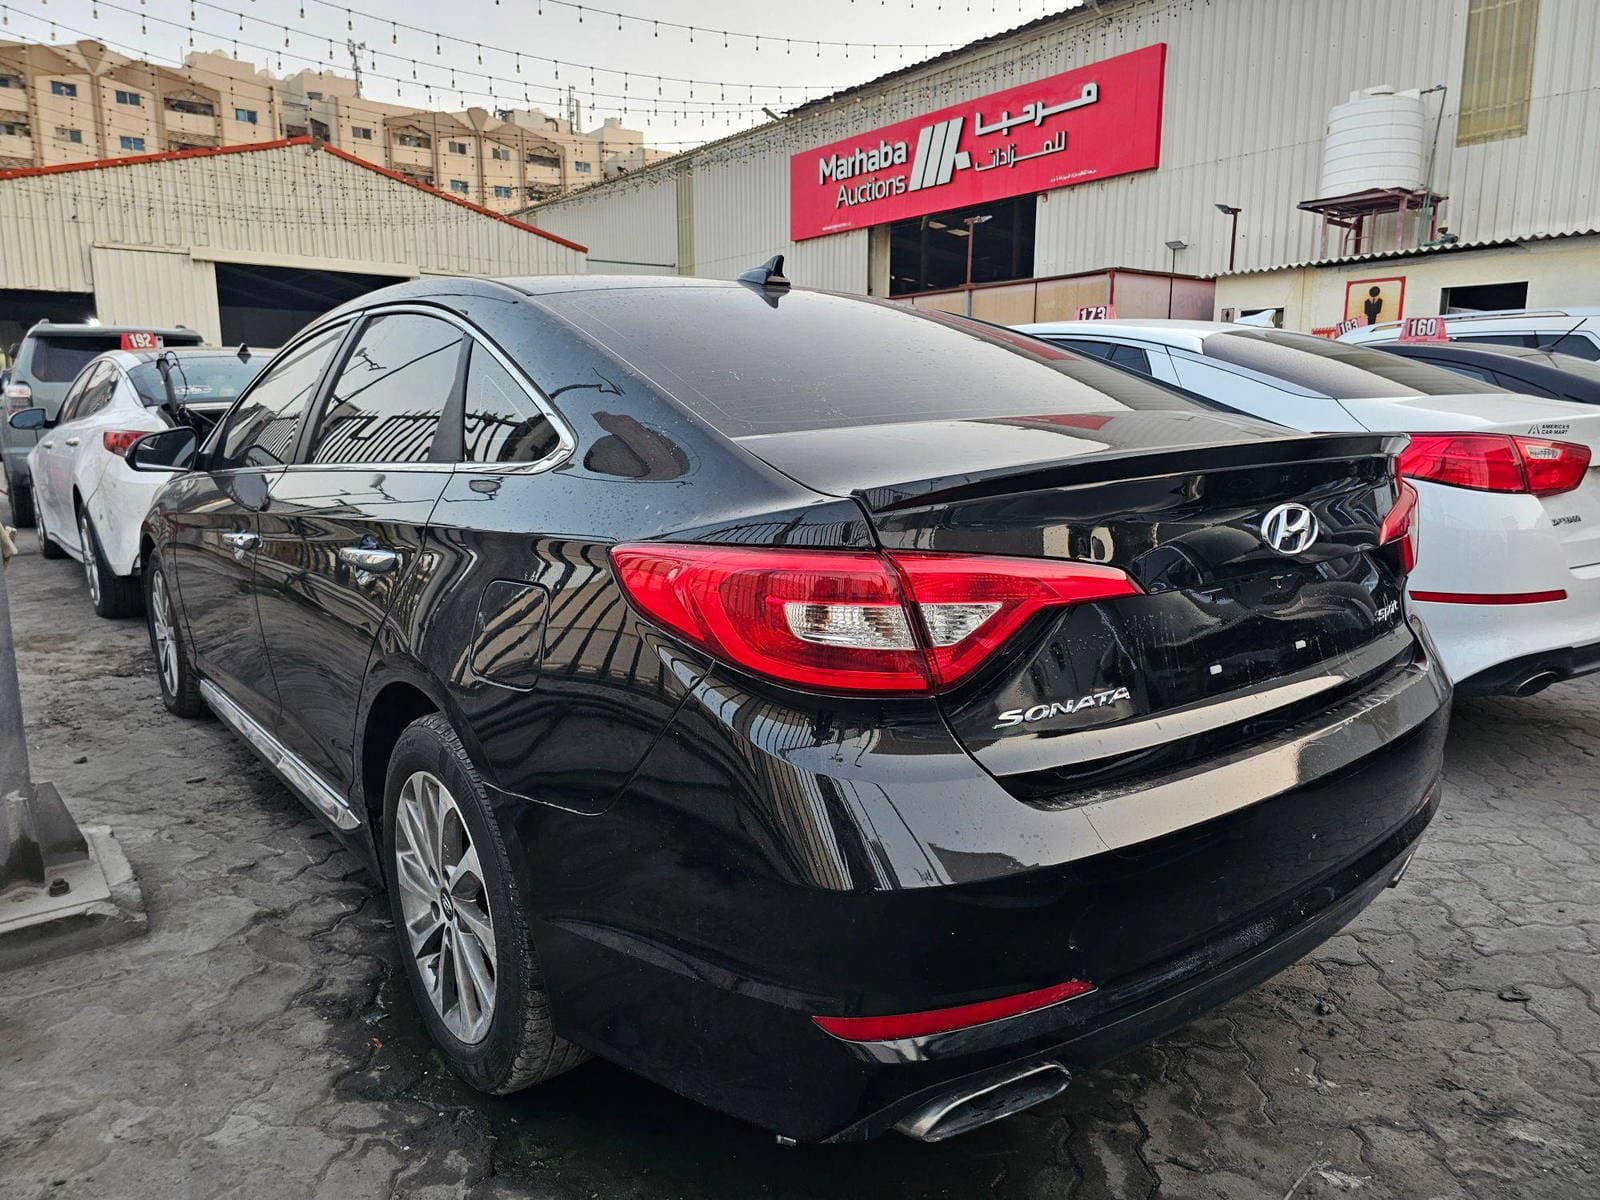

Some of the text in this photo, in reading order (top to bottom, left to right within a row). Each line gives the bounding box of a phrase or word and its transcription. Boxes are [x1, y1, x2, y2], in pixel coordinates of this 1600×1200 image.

[975, 81, 1098, 136] مرحبا
[818, 140, 907, 185] Marhaba
[975, 130, 1065, 171] للمزادات
[836, 174, 906, 208] Auctions
[1080, 306, 1106, 320] 173
[1340, 318, 1359, 335] 183
[1411, 318, 1437, 337] 160
[129, 333, 153, 348] 192
[992, 686, 1131, 730] SONATA
